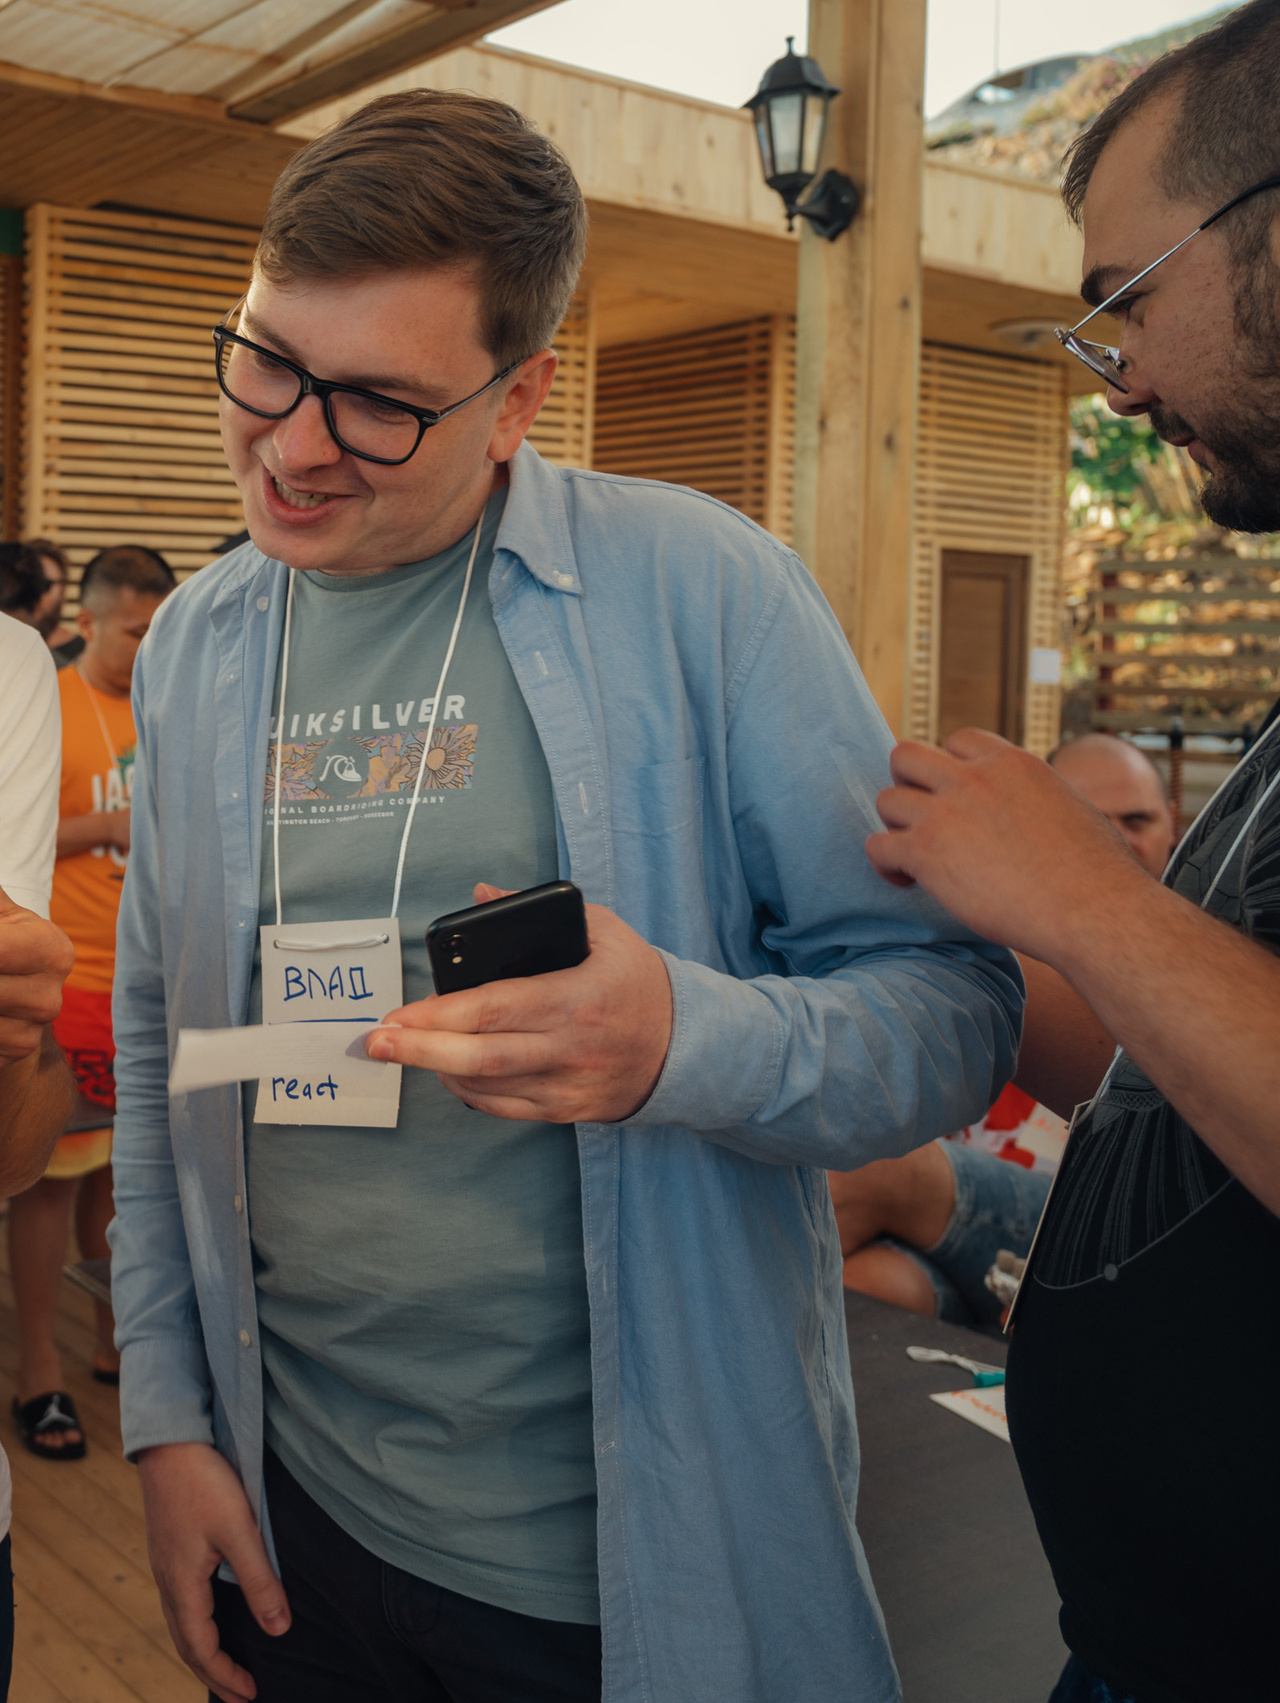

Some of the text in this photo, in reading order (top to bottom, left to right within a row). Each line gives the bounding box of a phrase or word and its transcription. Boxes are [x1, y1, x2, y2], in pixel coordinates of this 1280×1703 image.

[269, 695, 466, 739] UIKSILVER
[311, 800, 384, 814] BOARDRIDING
[284, 966, 374, 1001] ВЛАД
[272, 1074, 339, 1101] react
